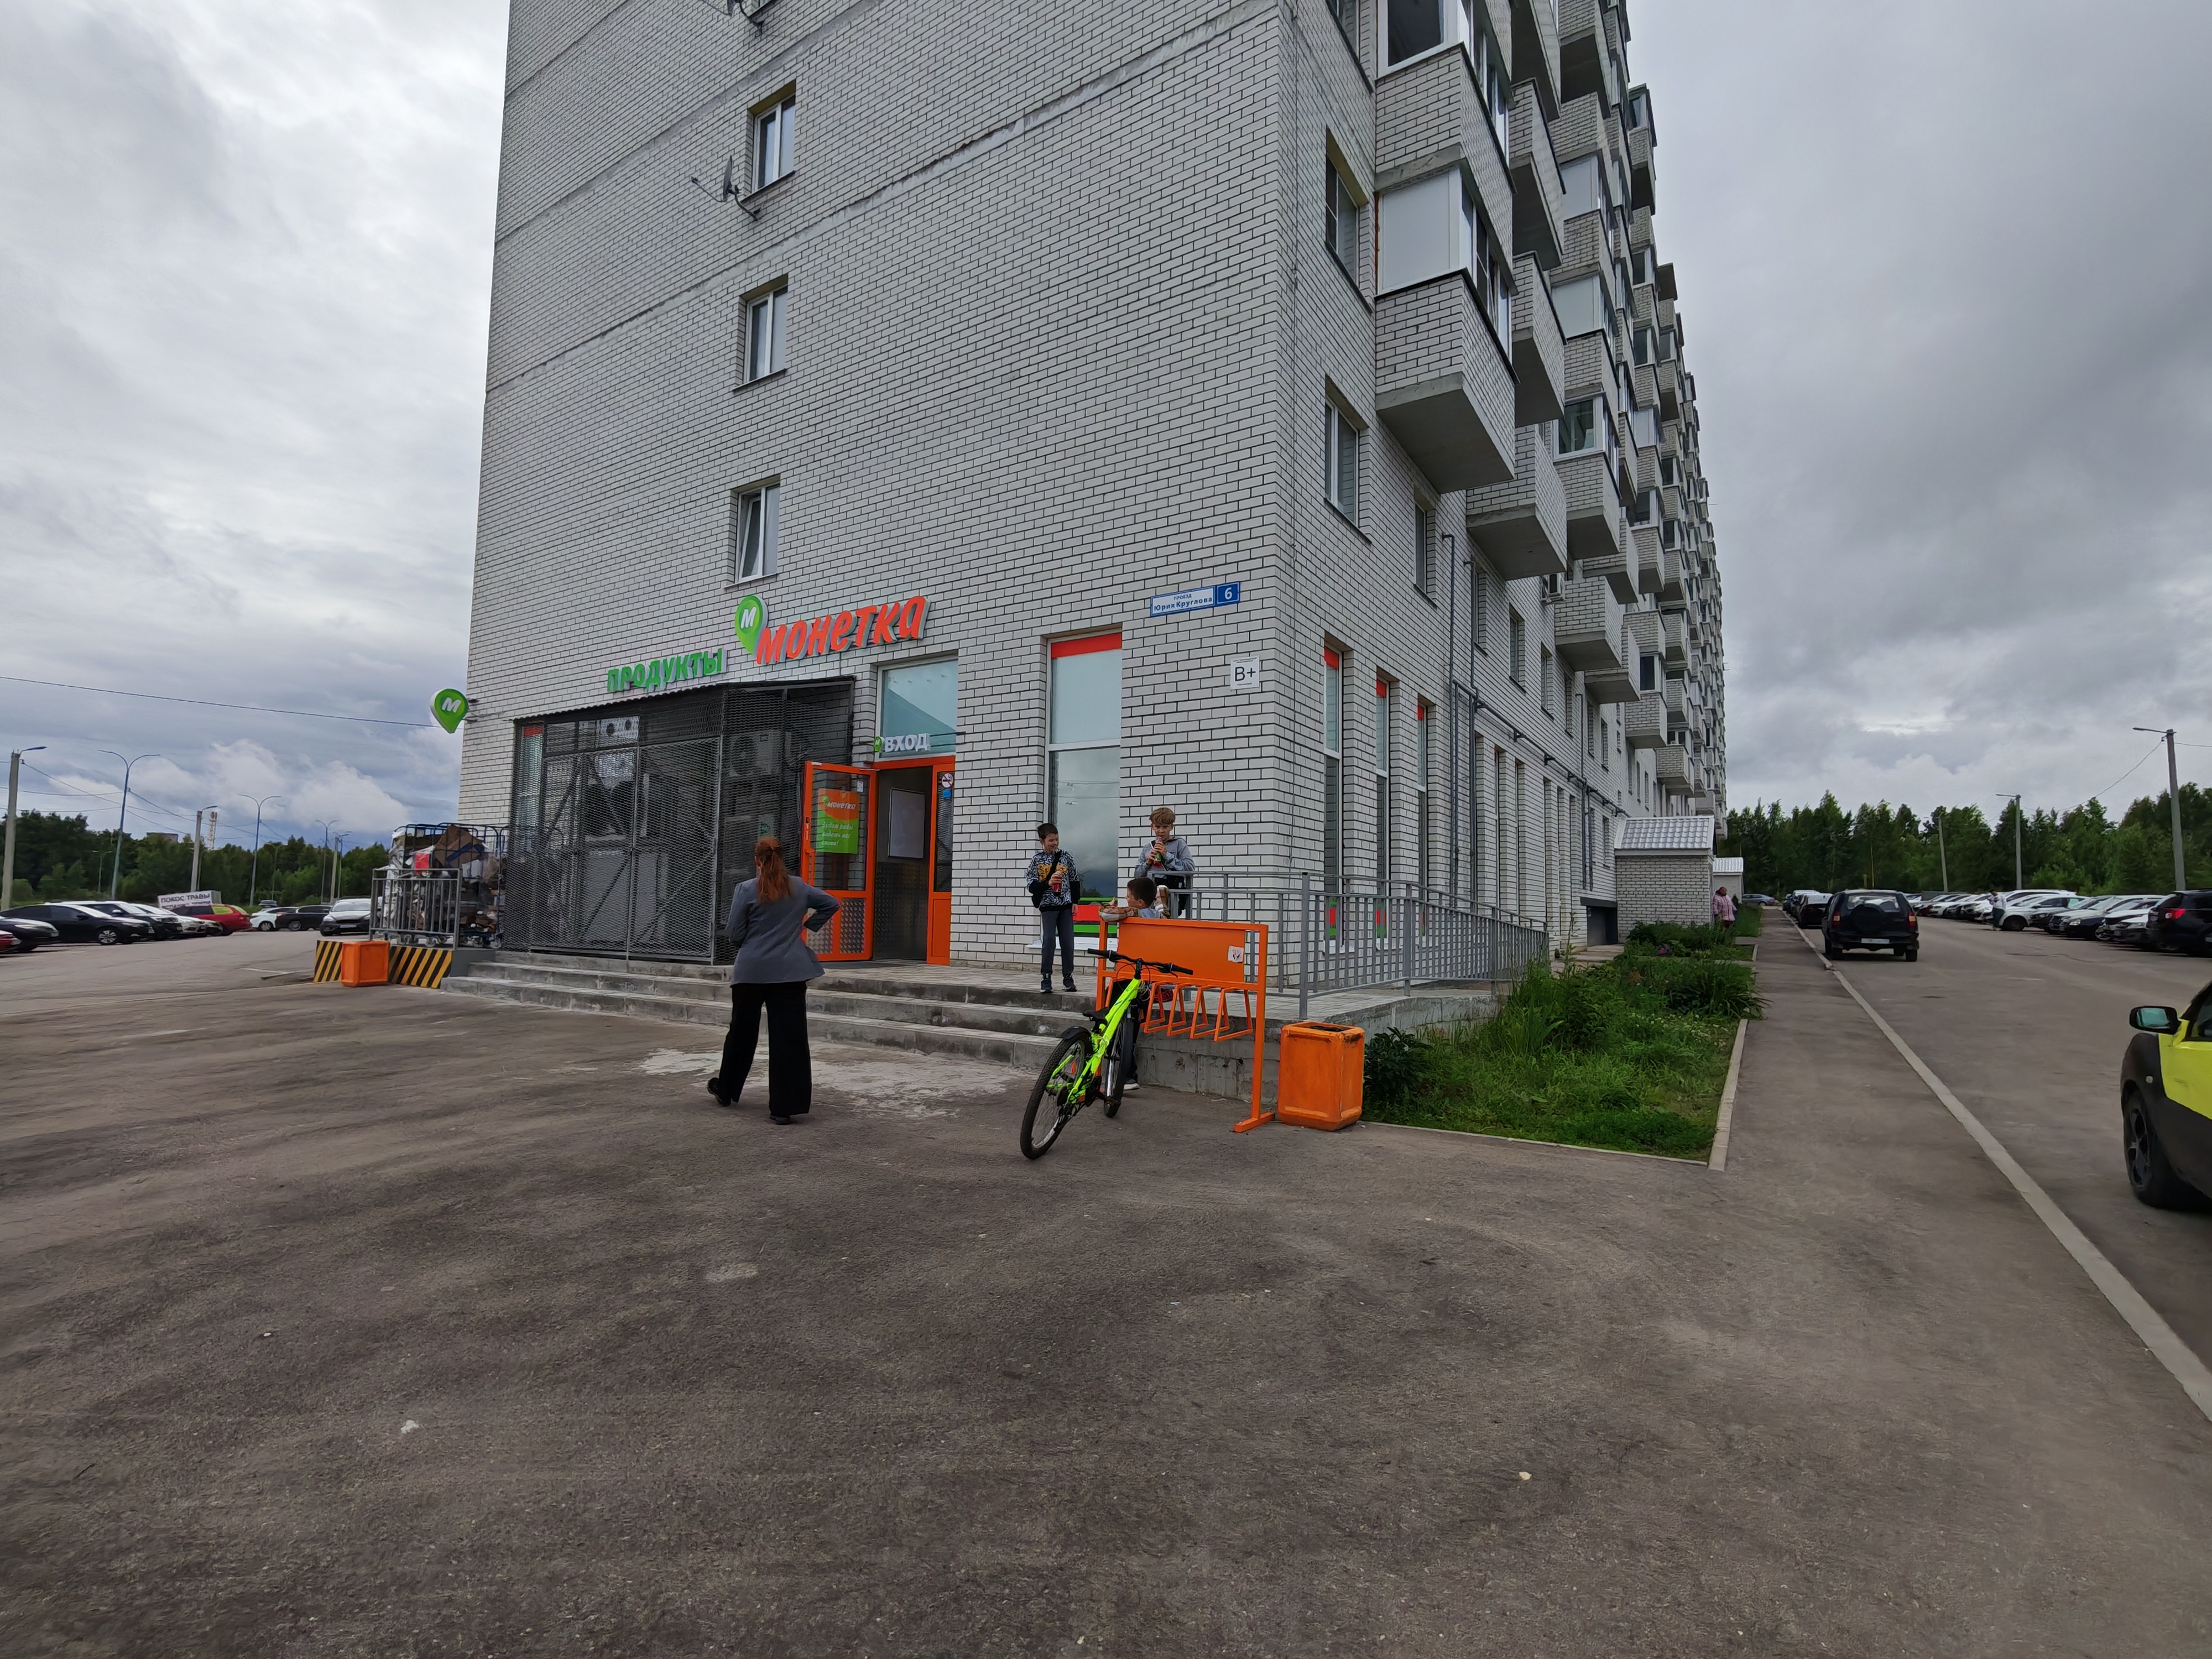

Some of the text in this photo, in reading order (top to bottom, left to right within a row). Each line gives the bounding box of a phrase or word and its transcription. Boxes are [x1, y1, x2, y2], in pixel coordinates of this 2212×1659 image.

[1224, 587, 1233, 600] 6
[1154, 597, 1212, 612] Юрия Круглова
[607, 648, 726, 692] ПРОДУКТЫ
[885, 733, 930, 752] ВХОД
